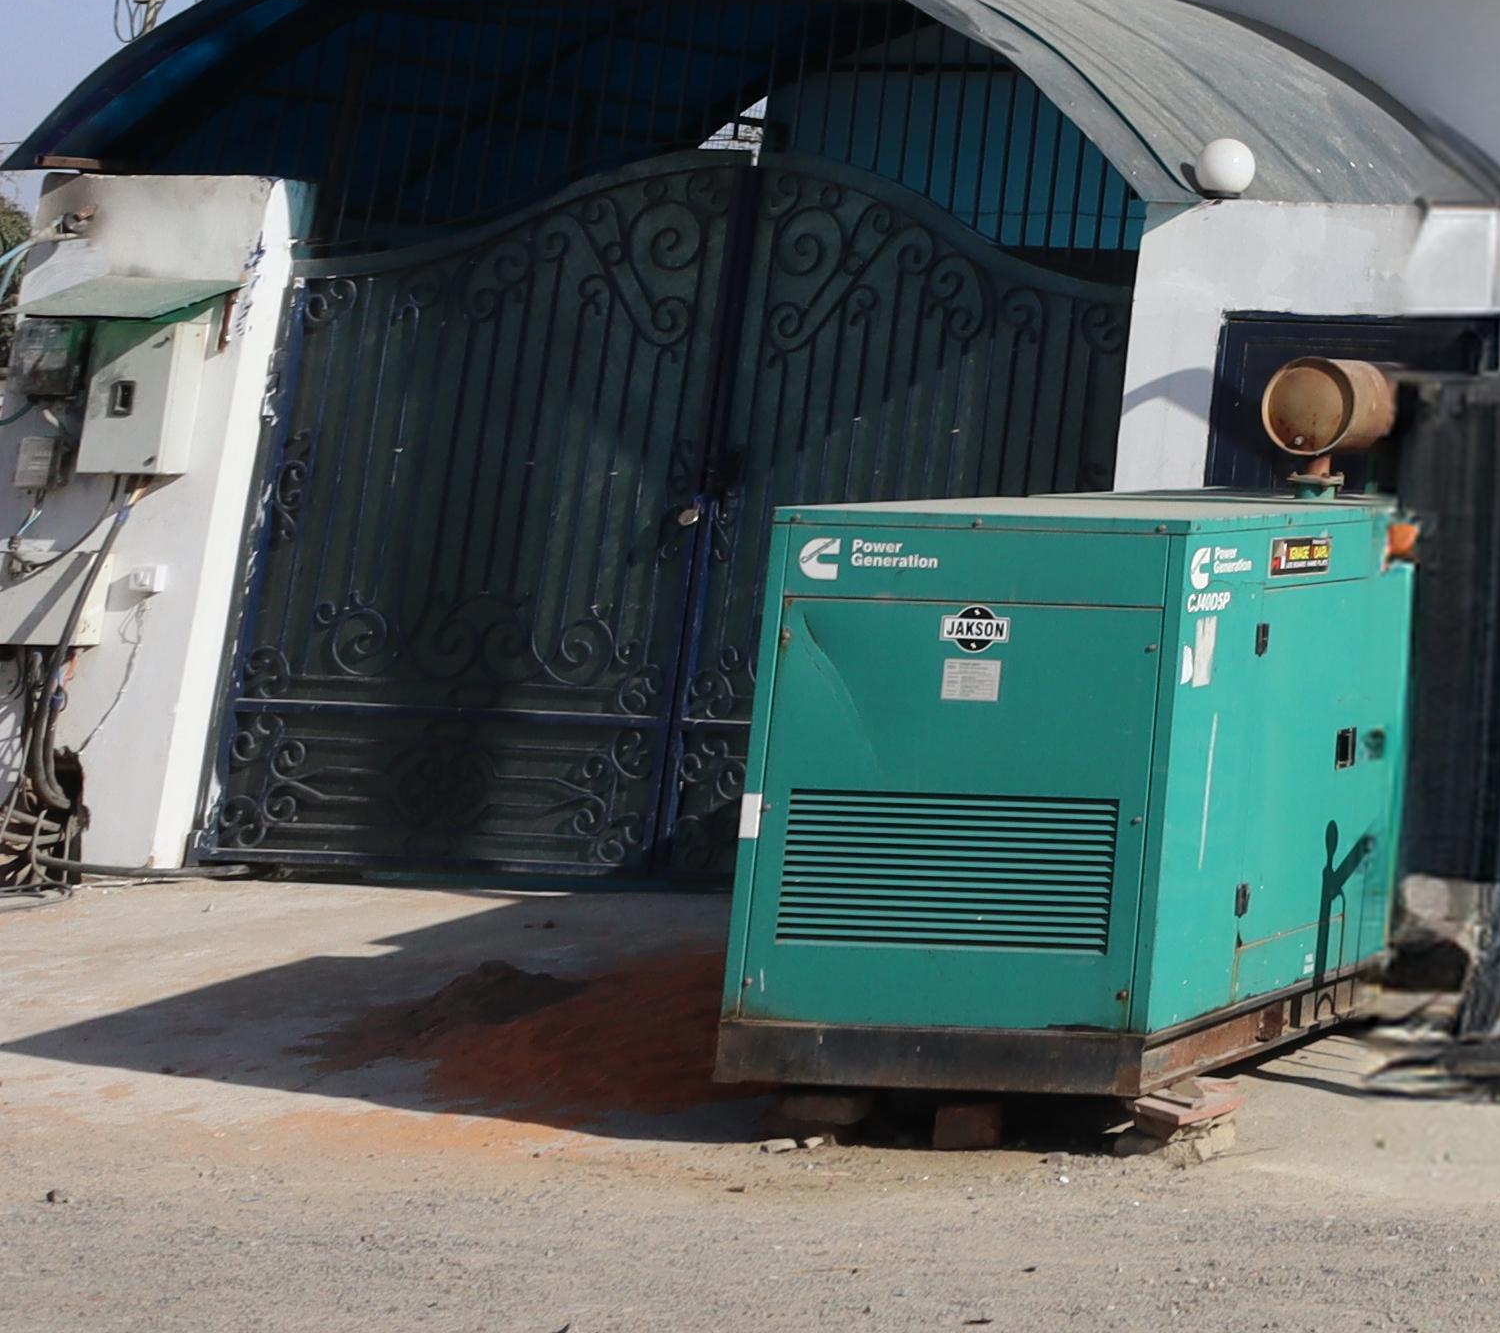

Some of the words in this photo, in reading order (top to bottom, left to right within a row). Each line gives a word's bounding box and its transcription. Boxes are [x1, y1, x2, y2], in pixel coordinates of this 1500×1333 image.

[851, 539, 903, 553] Power
[1213, 546, 1238, 559] Power
[850, 553, 939, 569] Generation
[1213, 558, 1253, 574] Generation
[946, 620, 1005, 638] JAKSON
